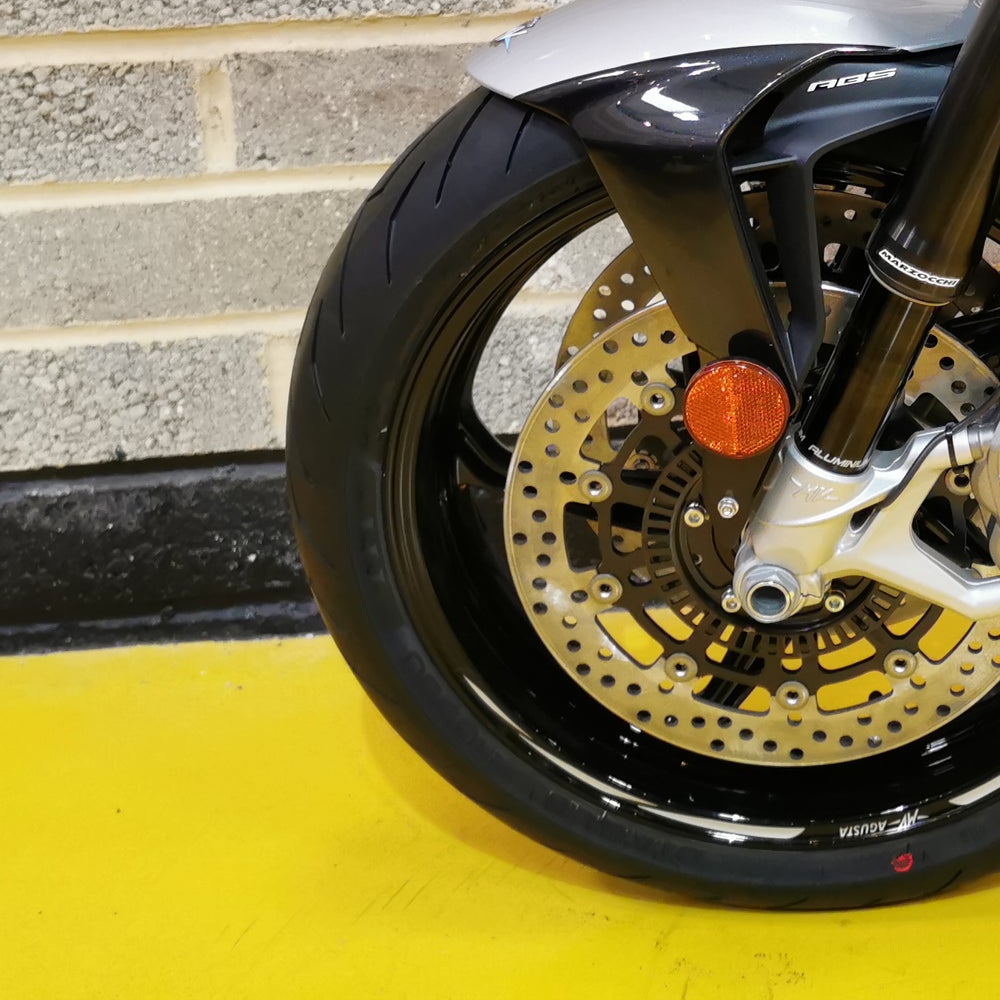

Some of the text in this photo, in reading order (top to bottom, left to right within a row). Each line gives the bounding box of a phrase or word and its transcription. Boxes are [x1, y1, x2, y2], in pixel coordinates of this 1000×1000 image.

[807, 67, 897, 93] ABS
[882, 250, 958, 286] MARZOCCHI
[839, 819, 888, 839] AGUSTA
